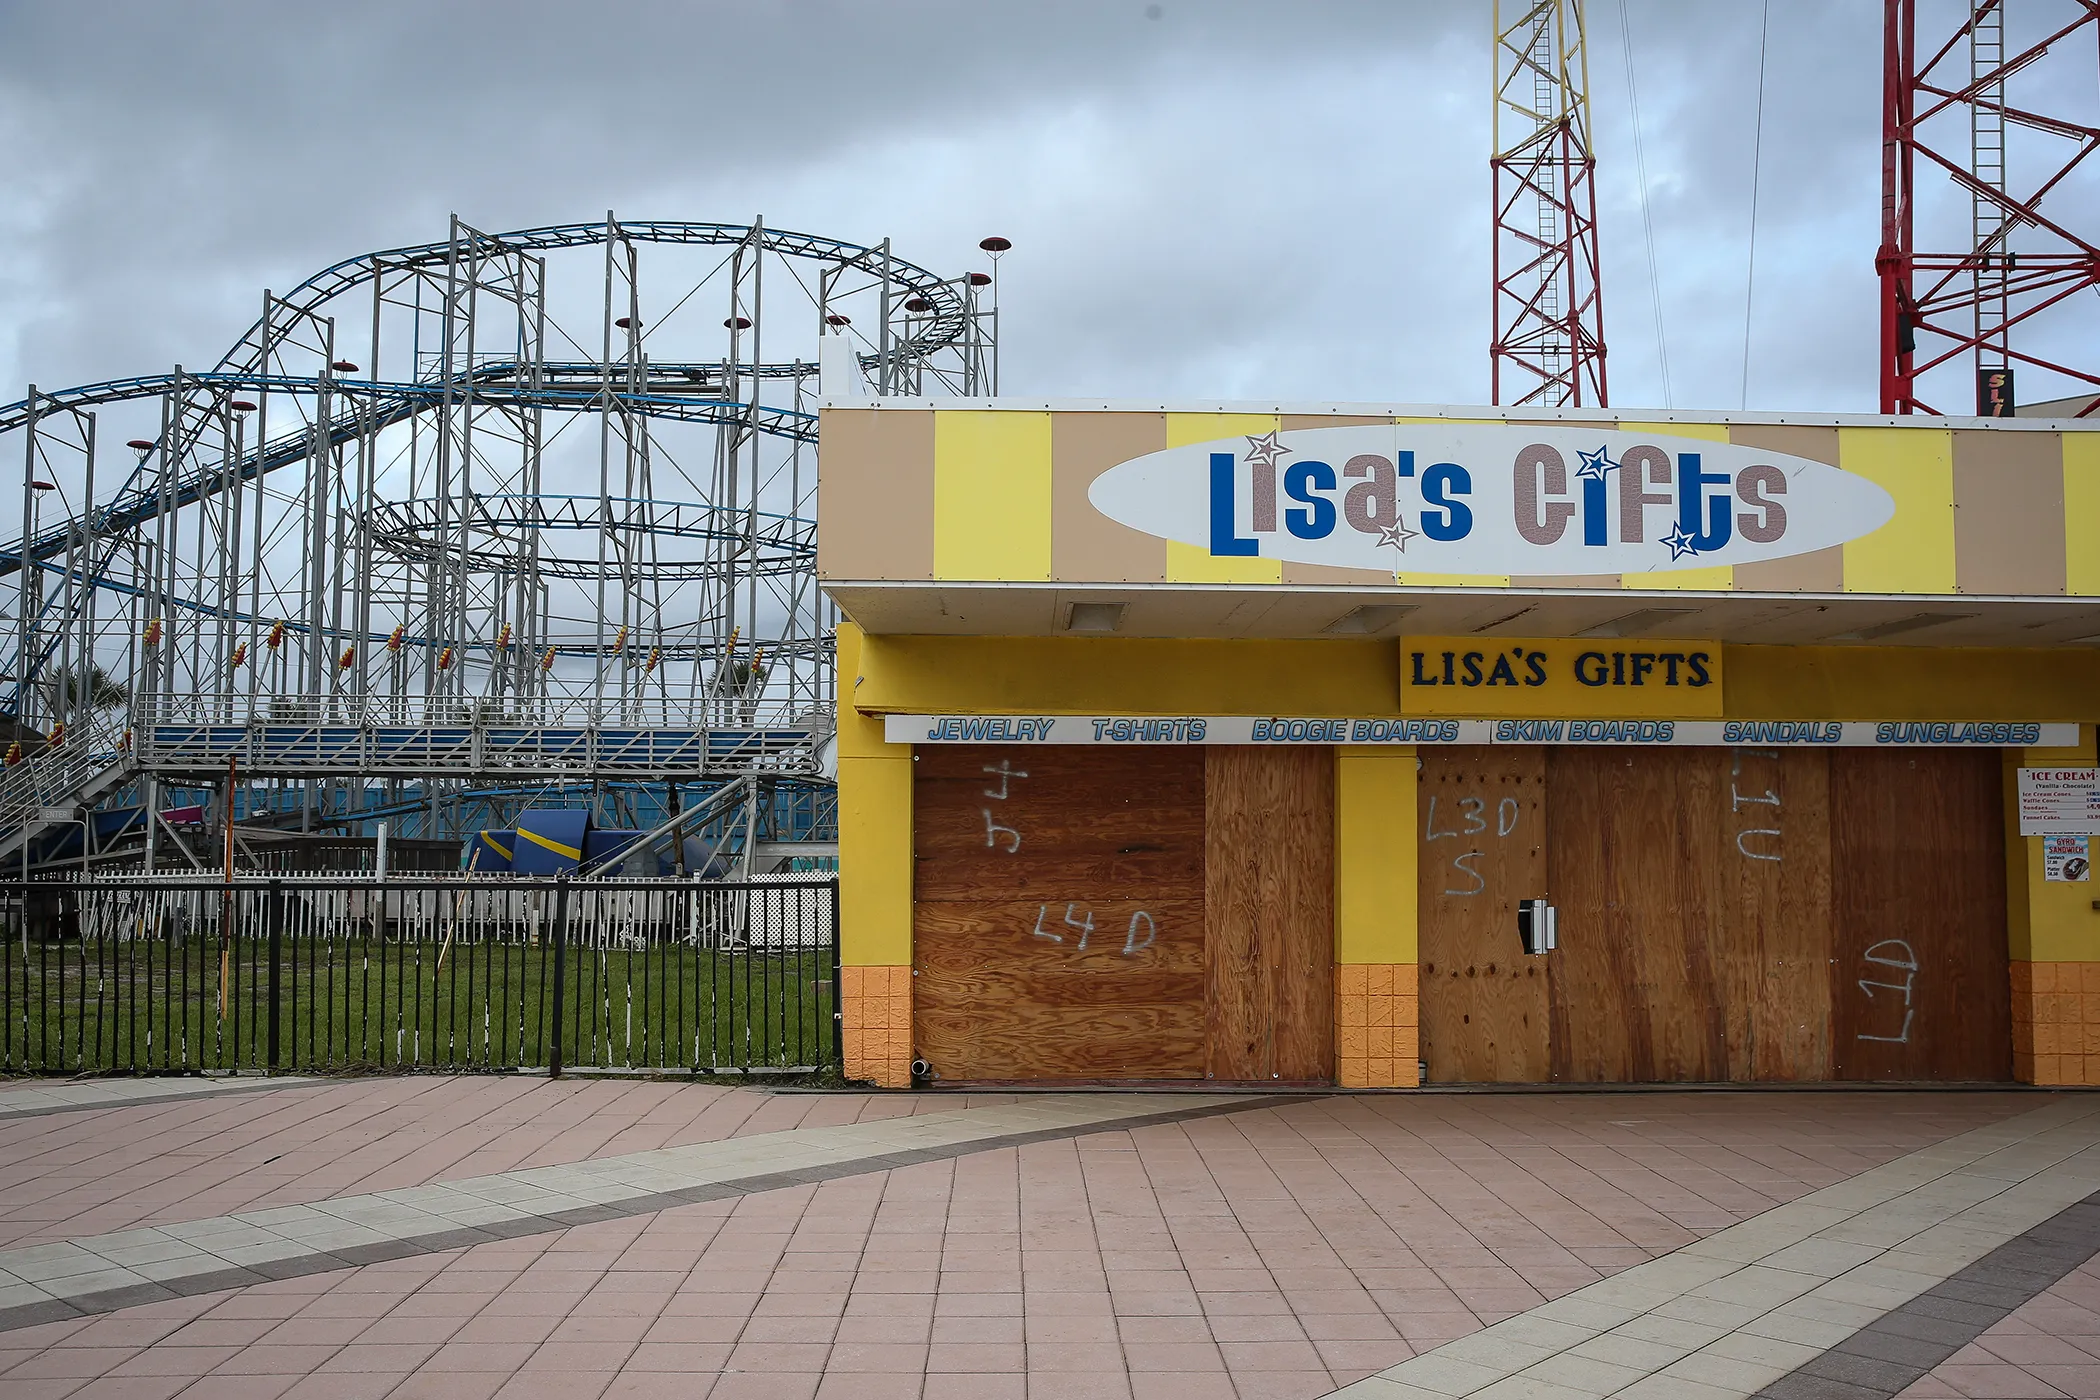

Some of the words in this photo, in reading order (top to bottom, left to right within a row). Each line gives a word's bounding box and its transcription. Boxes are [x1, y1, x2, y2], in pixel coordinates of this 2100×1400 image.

[1209, 430, 1473, 557] Lisa's
[1513, 443, 1788, 562] Gifts
[1411, 647, 1548, 687] LISA'S
[1573, 651, 1711, 688] GIFTS
[928, 718, 1055, 741] JEWELRY
[1092, 718, 1206, 742] T-SHIRTS
[1251, 719, 1347, 742] BOOGIE
[1350, 720, 1459, 742] BOARDS
[1495, 720, 1567, 742] SKIM
[1567, 720, 1675, 742] BOARDS
[1723, 721, 1843, 743] SANDALS
[1875, 722, 2041, 744] SUNGLASSES
[2031, 771, 2051, 781] ICE
[2054, 771, 2095, 781] CREAM
[45, 810, 68, 819] ENTER
[1426, 795, 1519, 841] L3D
[2048, 846, 2084, 855] SANDWICH
[2056, 837, 2076, 846] GYRO
